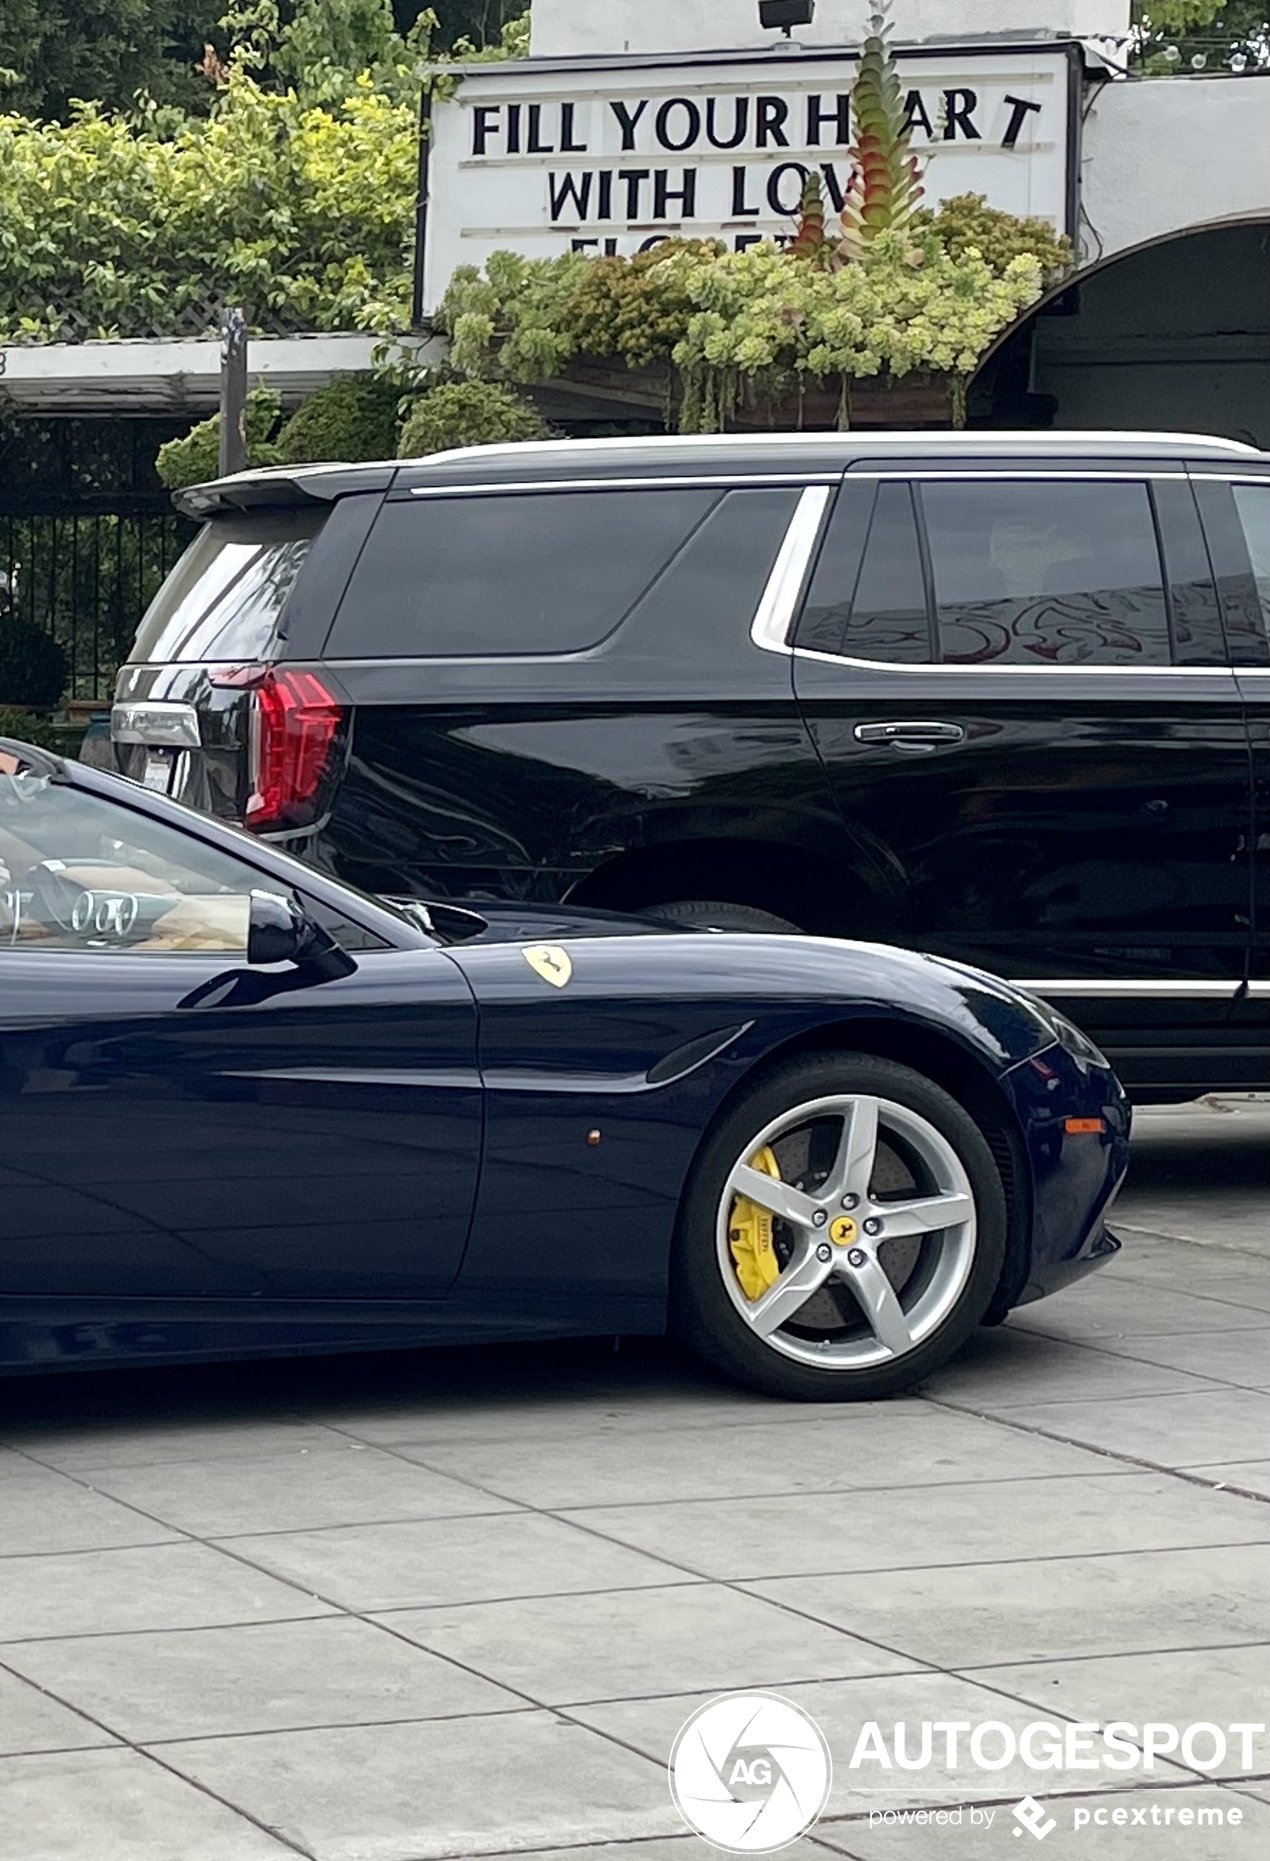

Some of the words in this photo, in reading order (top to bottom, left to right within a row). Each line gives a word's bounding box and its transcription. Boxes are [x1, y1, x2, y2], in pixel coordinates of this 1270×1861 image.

[472, 102, 587, 155] FILL
[609, 96, 790, 151] YOUR
[806, 88, 1042, 150] HART
[548, 167, 697, 221] WITH
[732, 161, 859, 216] LOV
